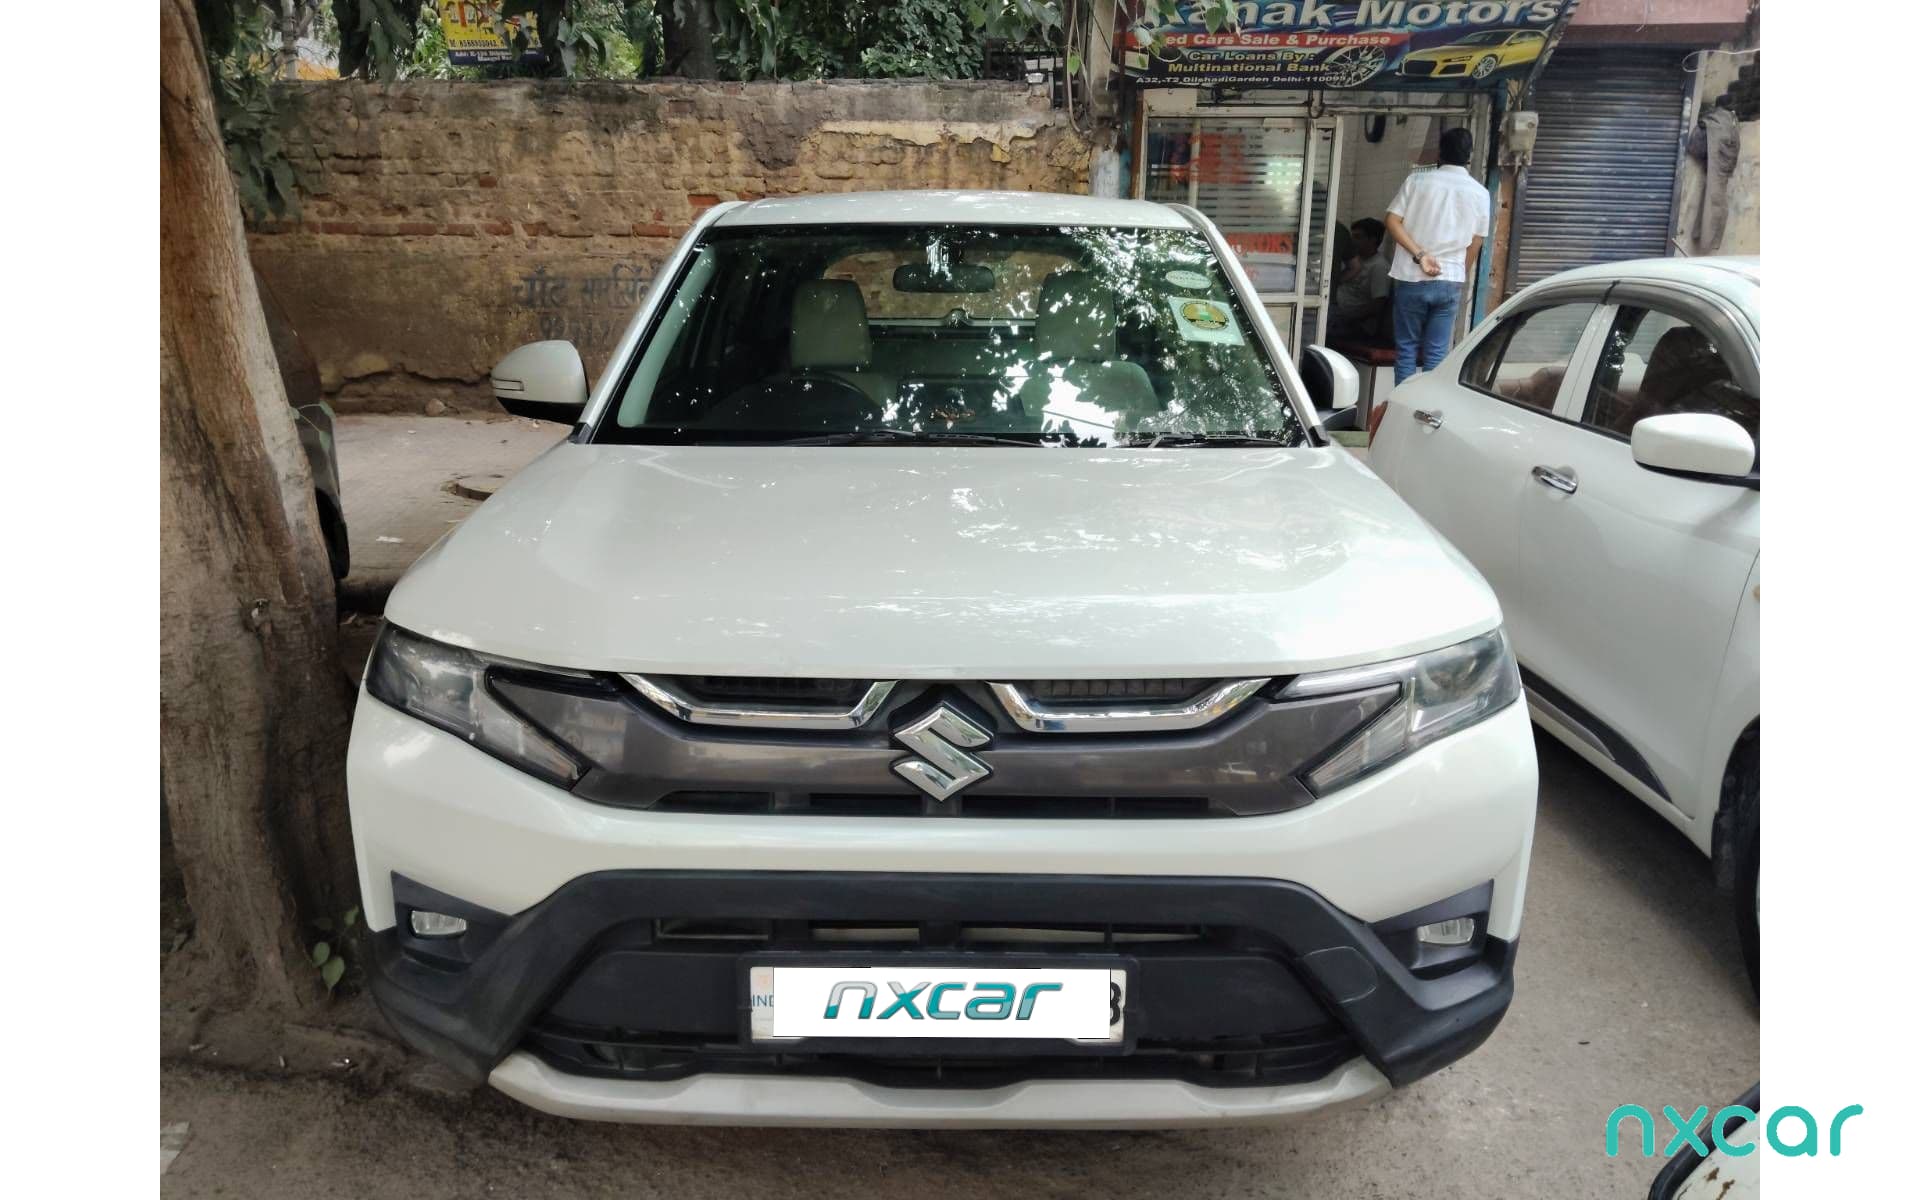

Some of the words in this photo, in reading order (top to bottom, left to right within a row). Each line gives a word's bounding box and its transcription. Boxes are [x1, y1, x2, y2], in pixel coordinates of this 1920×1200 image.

[1354, 0, 1560, 25] Motors
[1193, 34, 1234, 45] Cars
[1240, 34, 1280, 45] Sale
[1286, 34, 1299, 45] &
[1305, 34, 1391, 45] Purchase
[1189, 52, 1219, 60] Car
[1226, 51, 1278, 60] Loans
[1168, 63, 1281, 72] Multinational
[1287, 63, 1330, 72] Bank
